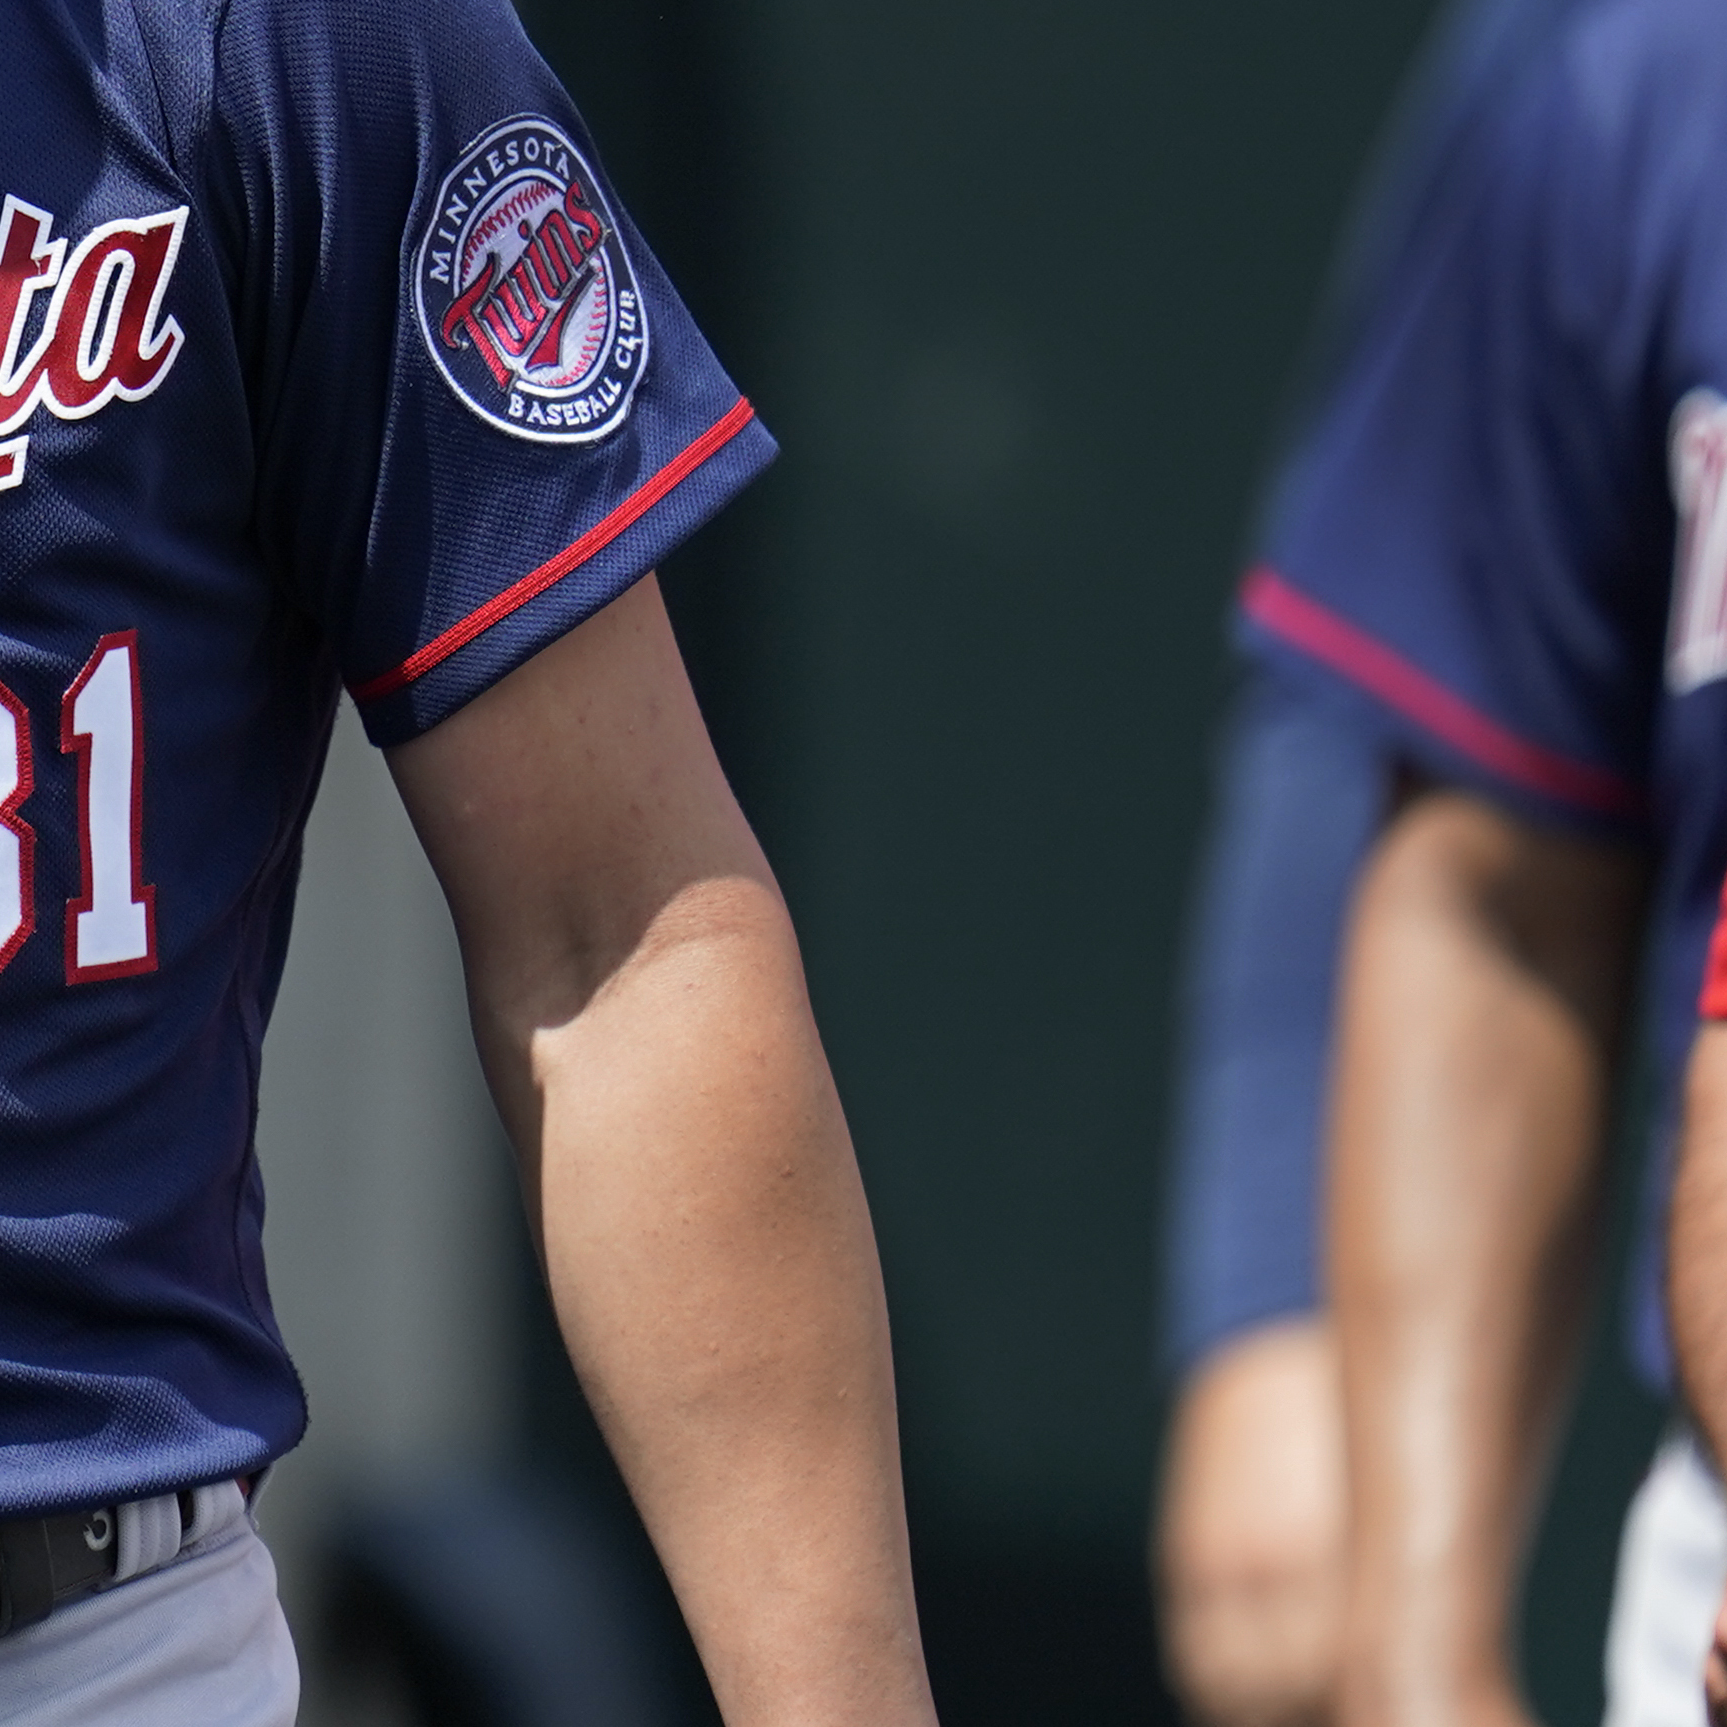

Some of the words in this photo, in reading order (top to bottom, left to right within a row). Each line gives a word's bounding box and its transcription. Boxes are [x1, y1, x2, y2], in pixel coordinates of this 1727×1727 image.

[430, 137, 570, 284] MINNESOTA
[440, 180, 608, 393] Twins
[507, 375, 623, 427] BASEBALL
[614, 288, 644, 370] CLUB
